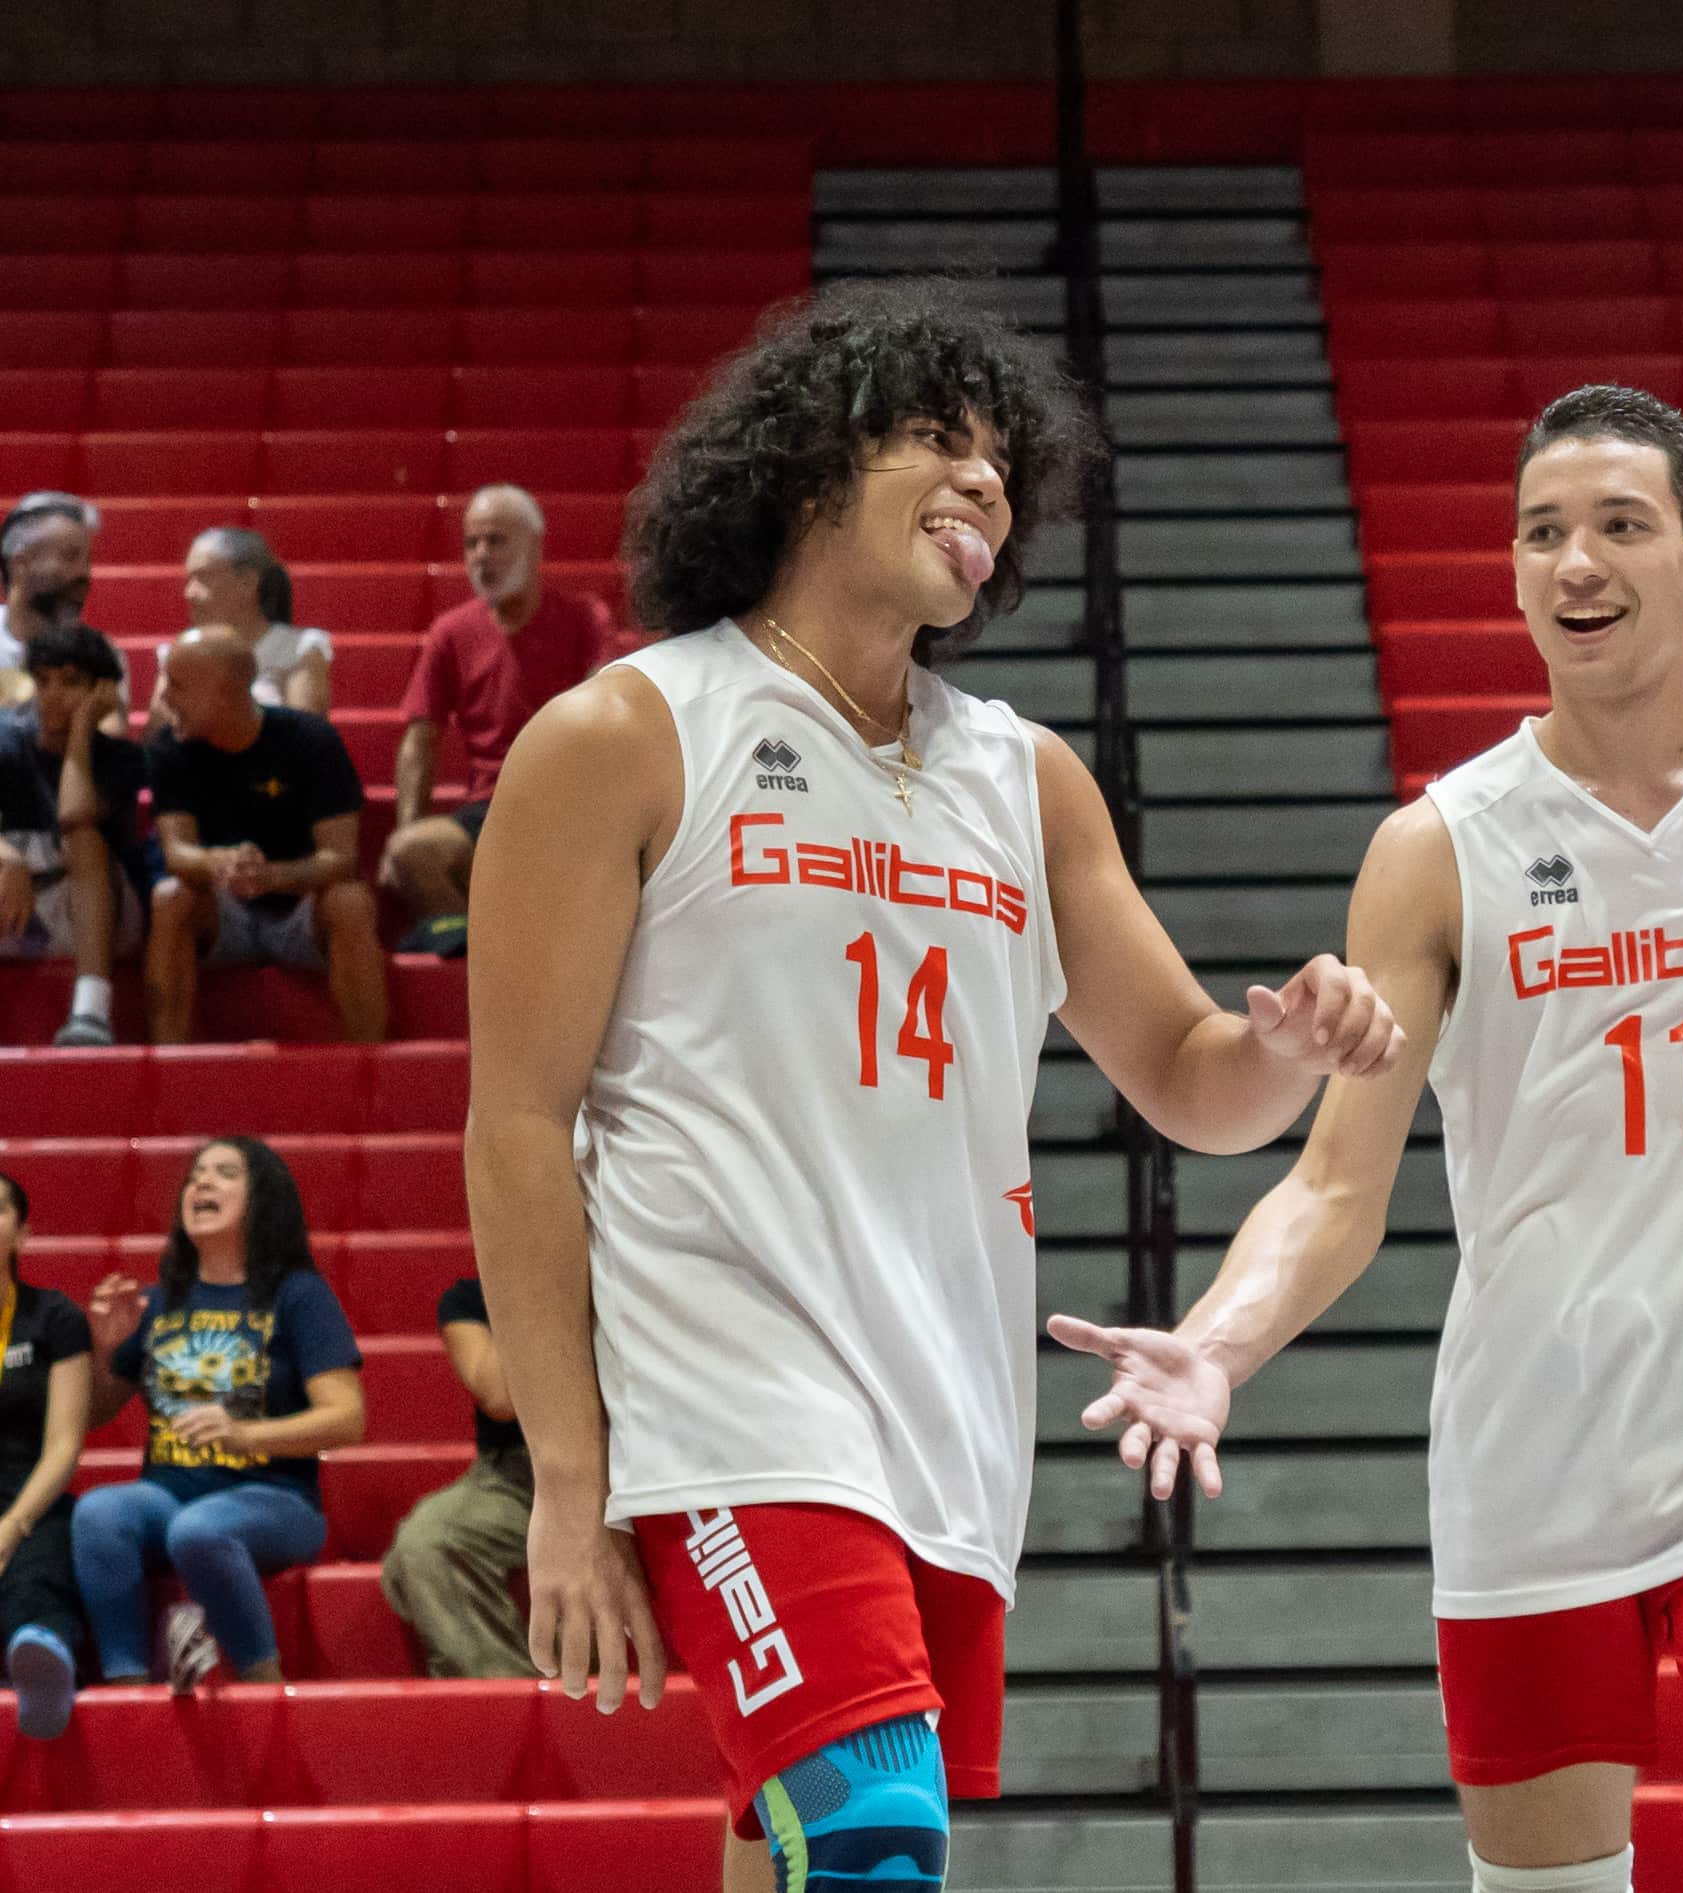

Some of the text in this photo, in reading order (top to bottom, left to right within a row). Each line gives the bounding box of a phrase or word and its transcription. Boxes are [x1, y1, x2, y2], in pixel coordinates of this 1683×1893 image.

[756, 774, 809, 794] errea
[729, 812, 1028, 936] Gallitos
[1529, 887, 1579, 906] errea
[845, 931, 954, 1101] 14
